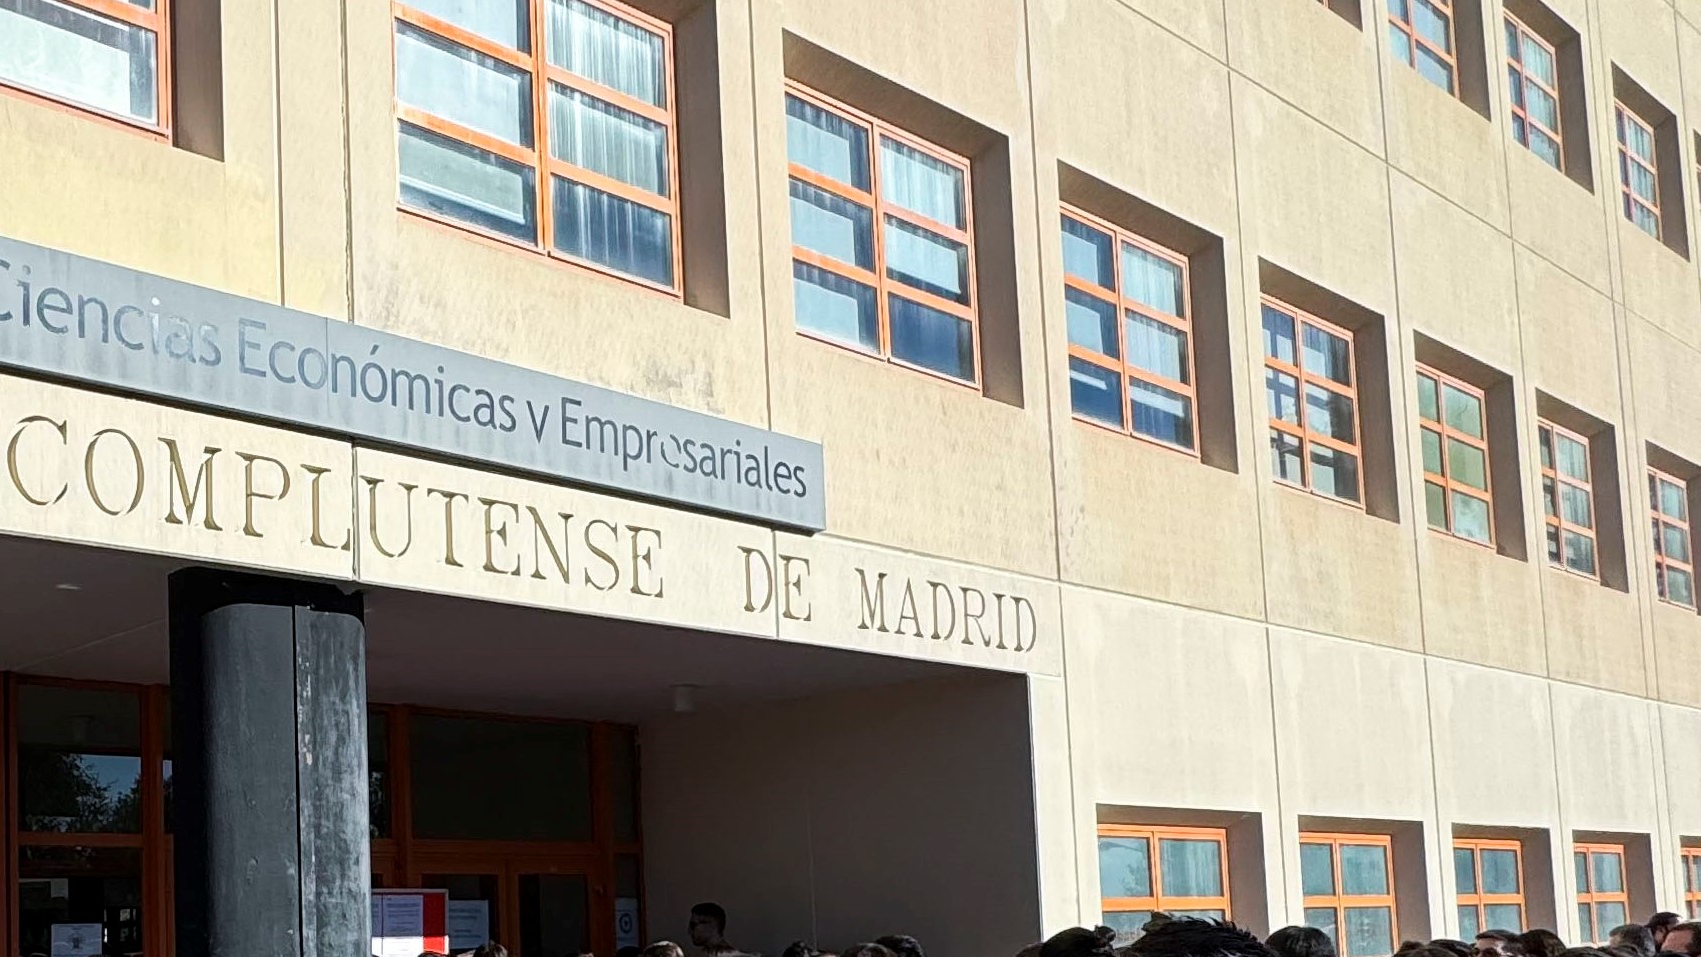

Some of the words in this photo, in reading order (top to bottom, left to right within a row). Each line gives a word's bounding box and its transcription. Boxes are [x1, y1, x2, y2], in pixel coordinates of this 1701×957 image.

[237, 316, 517, 433] Económicas
[560, 396, 807, 498] Empresariales
[6, 414, 664, 599] COMPLUTENSE
[736, 545, 812, 622] DE
[854, 567, 1037, 653] MADRID
